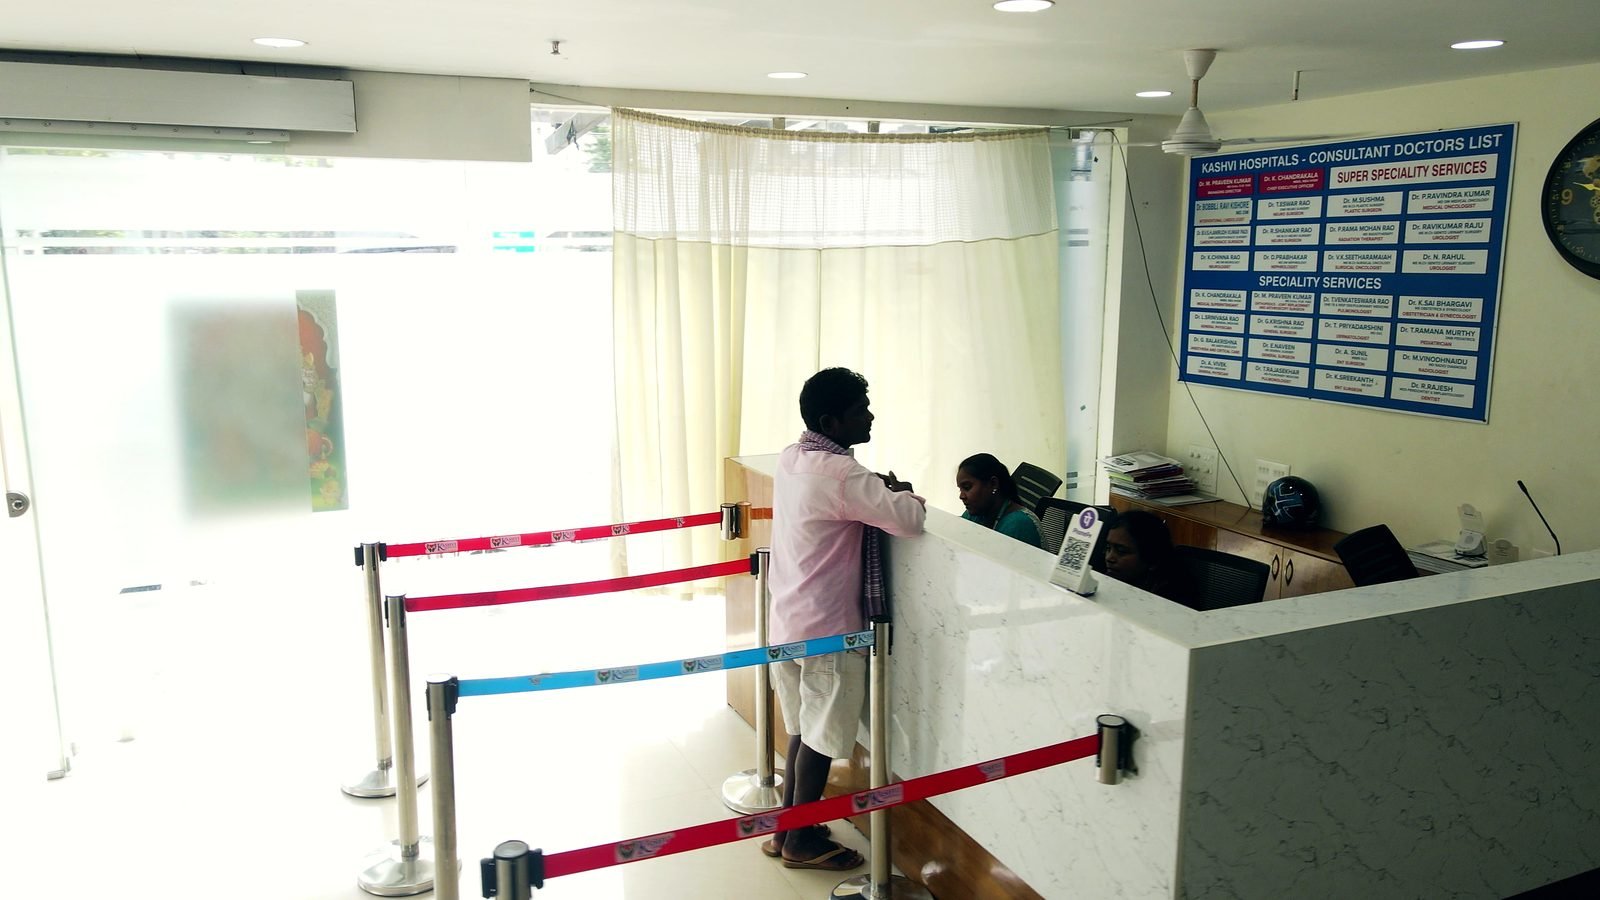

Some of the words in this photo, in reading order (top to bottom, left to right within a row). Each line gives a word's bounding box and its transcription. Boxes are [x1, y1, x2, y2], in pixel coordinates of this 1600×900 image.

[1202, 160, 1237, 173] KASHVI
[1240, 153, 1299, 170] HOSPITALS
[1309, 145, 1391, 164] CONSULTANT
[1394, 138, 1464, 156] DOCTORS
[1469, 133, 1503, 150] LIST
[1337, 170, 1368, 183] SUPER
[1371, 165, 1430, 180] SPECIALITY
[1432, 161, 1487, 176] SERVICES
[1422, 191, 1462, 199] P.RAVINDRA
[1562, 189, 1573, 205] 9
[1259, 276, 1320, 287] SPECIALITY
[1323, 277, 1382, 289] SERVICES
[1339, 323, 1384, 331] PRIYADARSHINI
[1412, 354, 1468, 365] M.VINODHNAIDU
[1334, 374, 1374, 383] K.SREEKANTH
[1421, 383, 1453, 392] R.RAJESH
